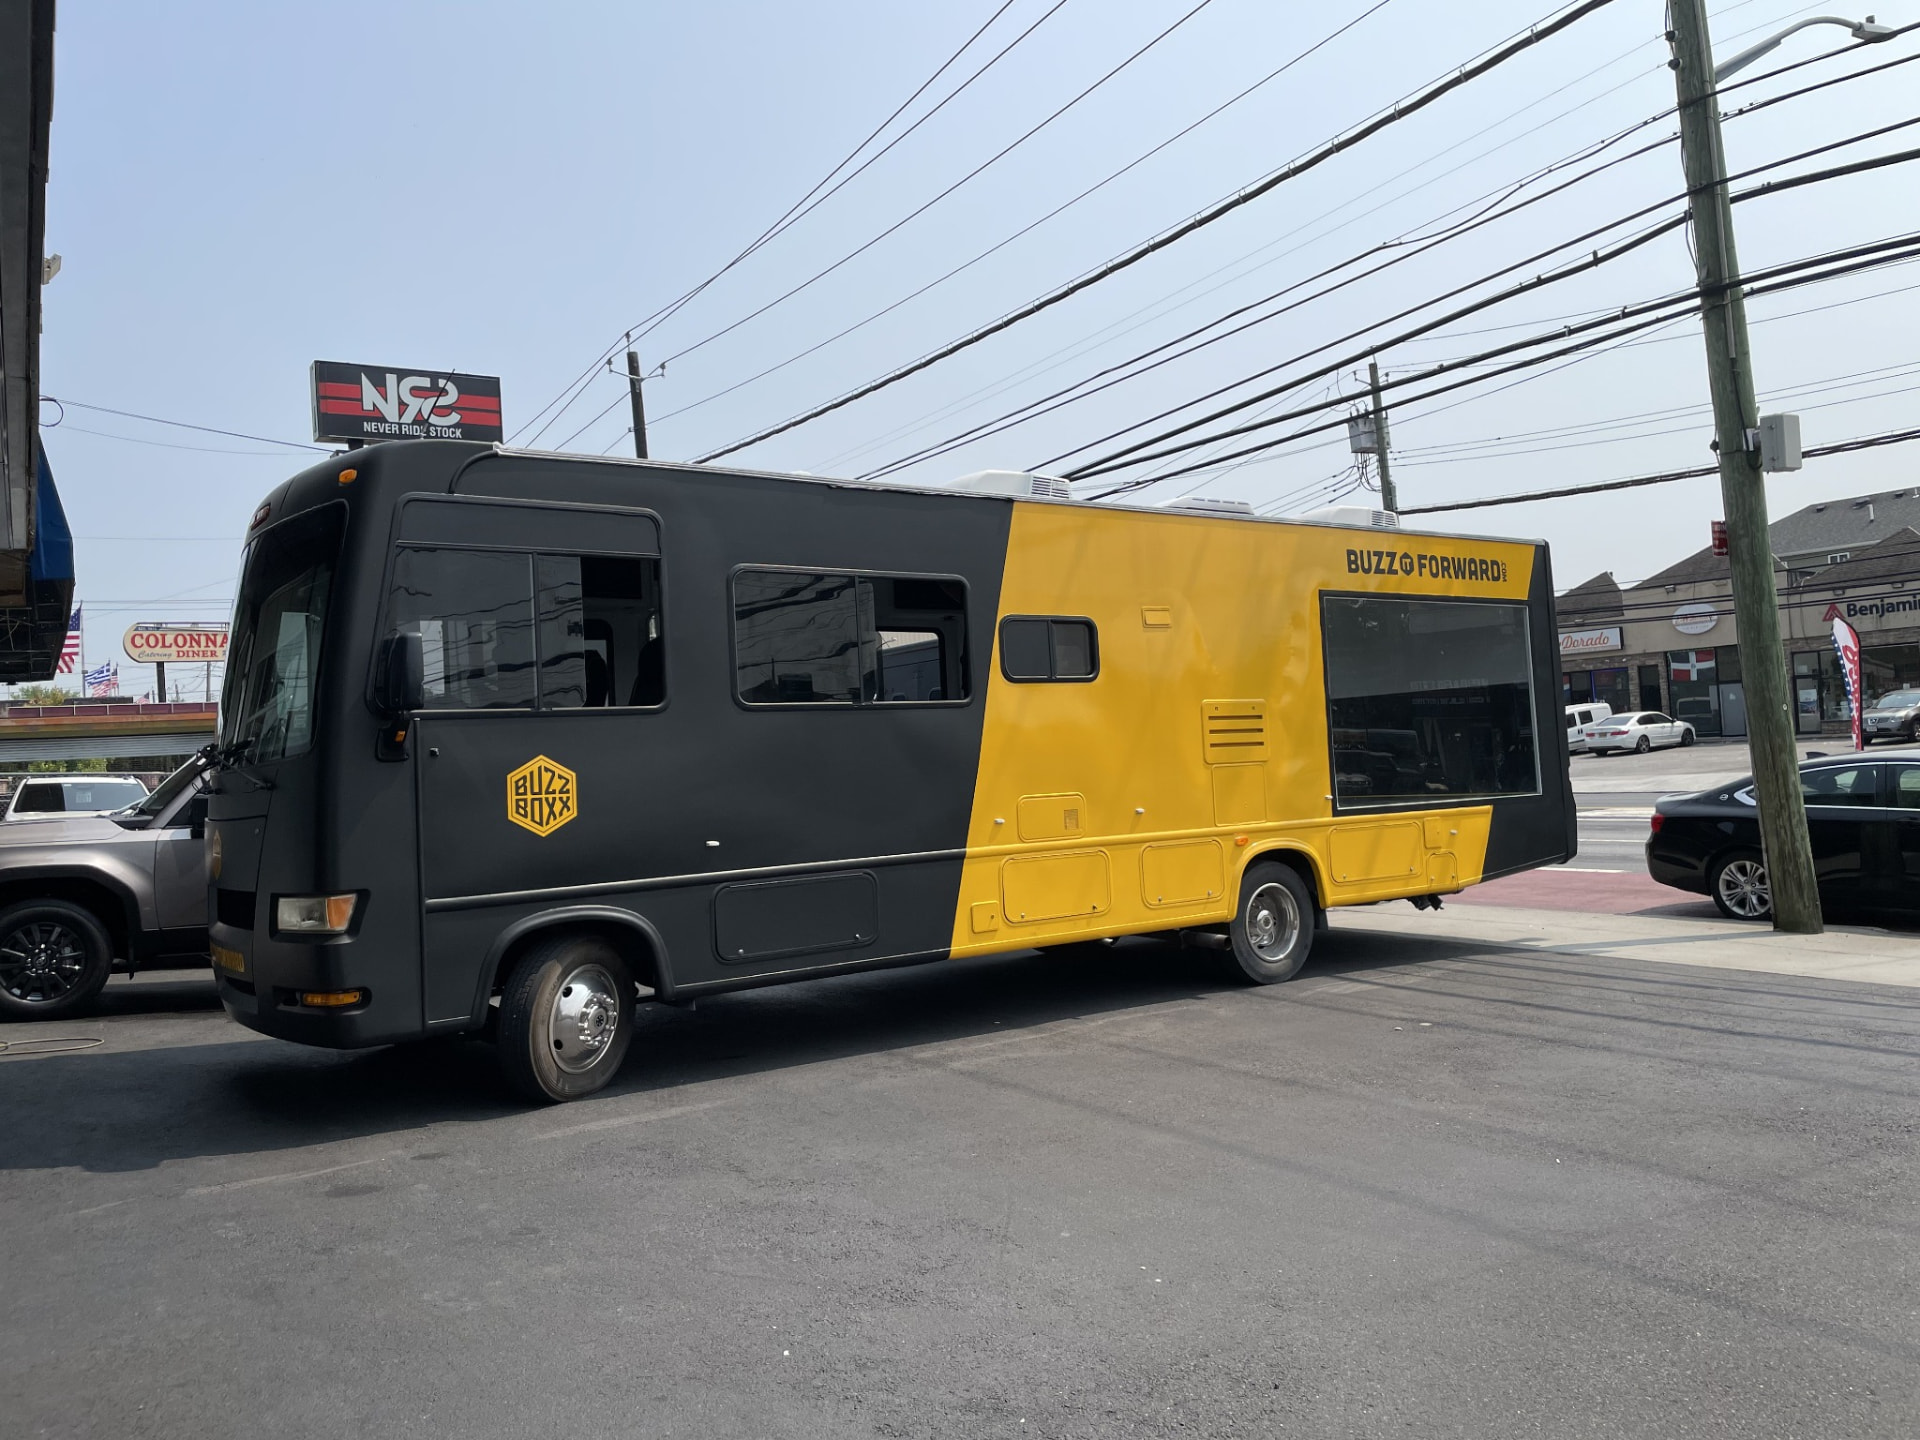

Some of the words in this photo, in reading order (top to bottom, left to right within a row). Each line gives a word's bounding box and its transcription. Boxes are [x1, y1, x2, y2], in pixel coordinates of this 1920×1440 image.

[363, 421, 400, 435] NEVER
[430, 427, 462, 439] STOCK
[1346, 549, 1399, 576] BUZZ
[1417, 554, 1501, 582] FORWARD
[1846, 595, 1920, 617] Benjami
[1561, 632, 1610, 649] Dorado
[176, 650, 218, 658] DINER
[514, 765, 570, 796] BUZZ
[515, 796, 571, 828] BOXX
